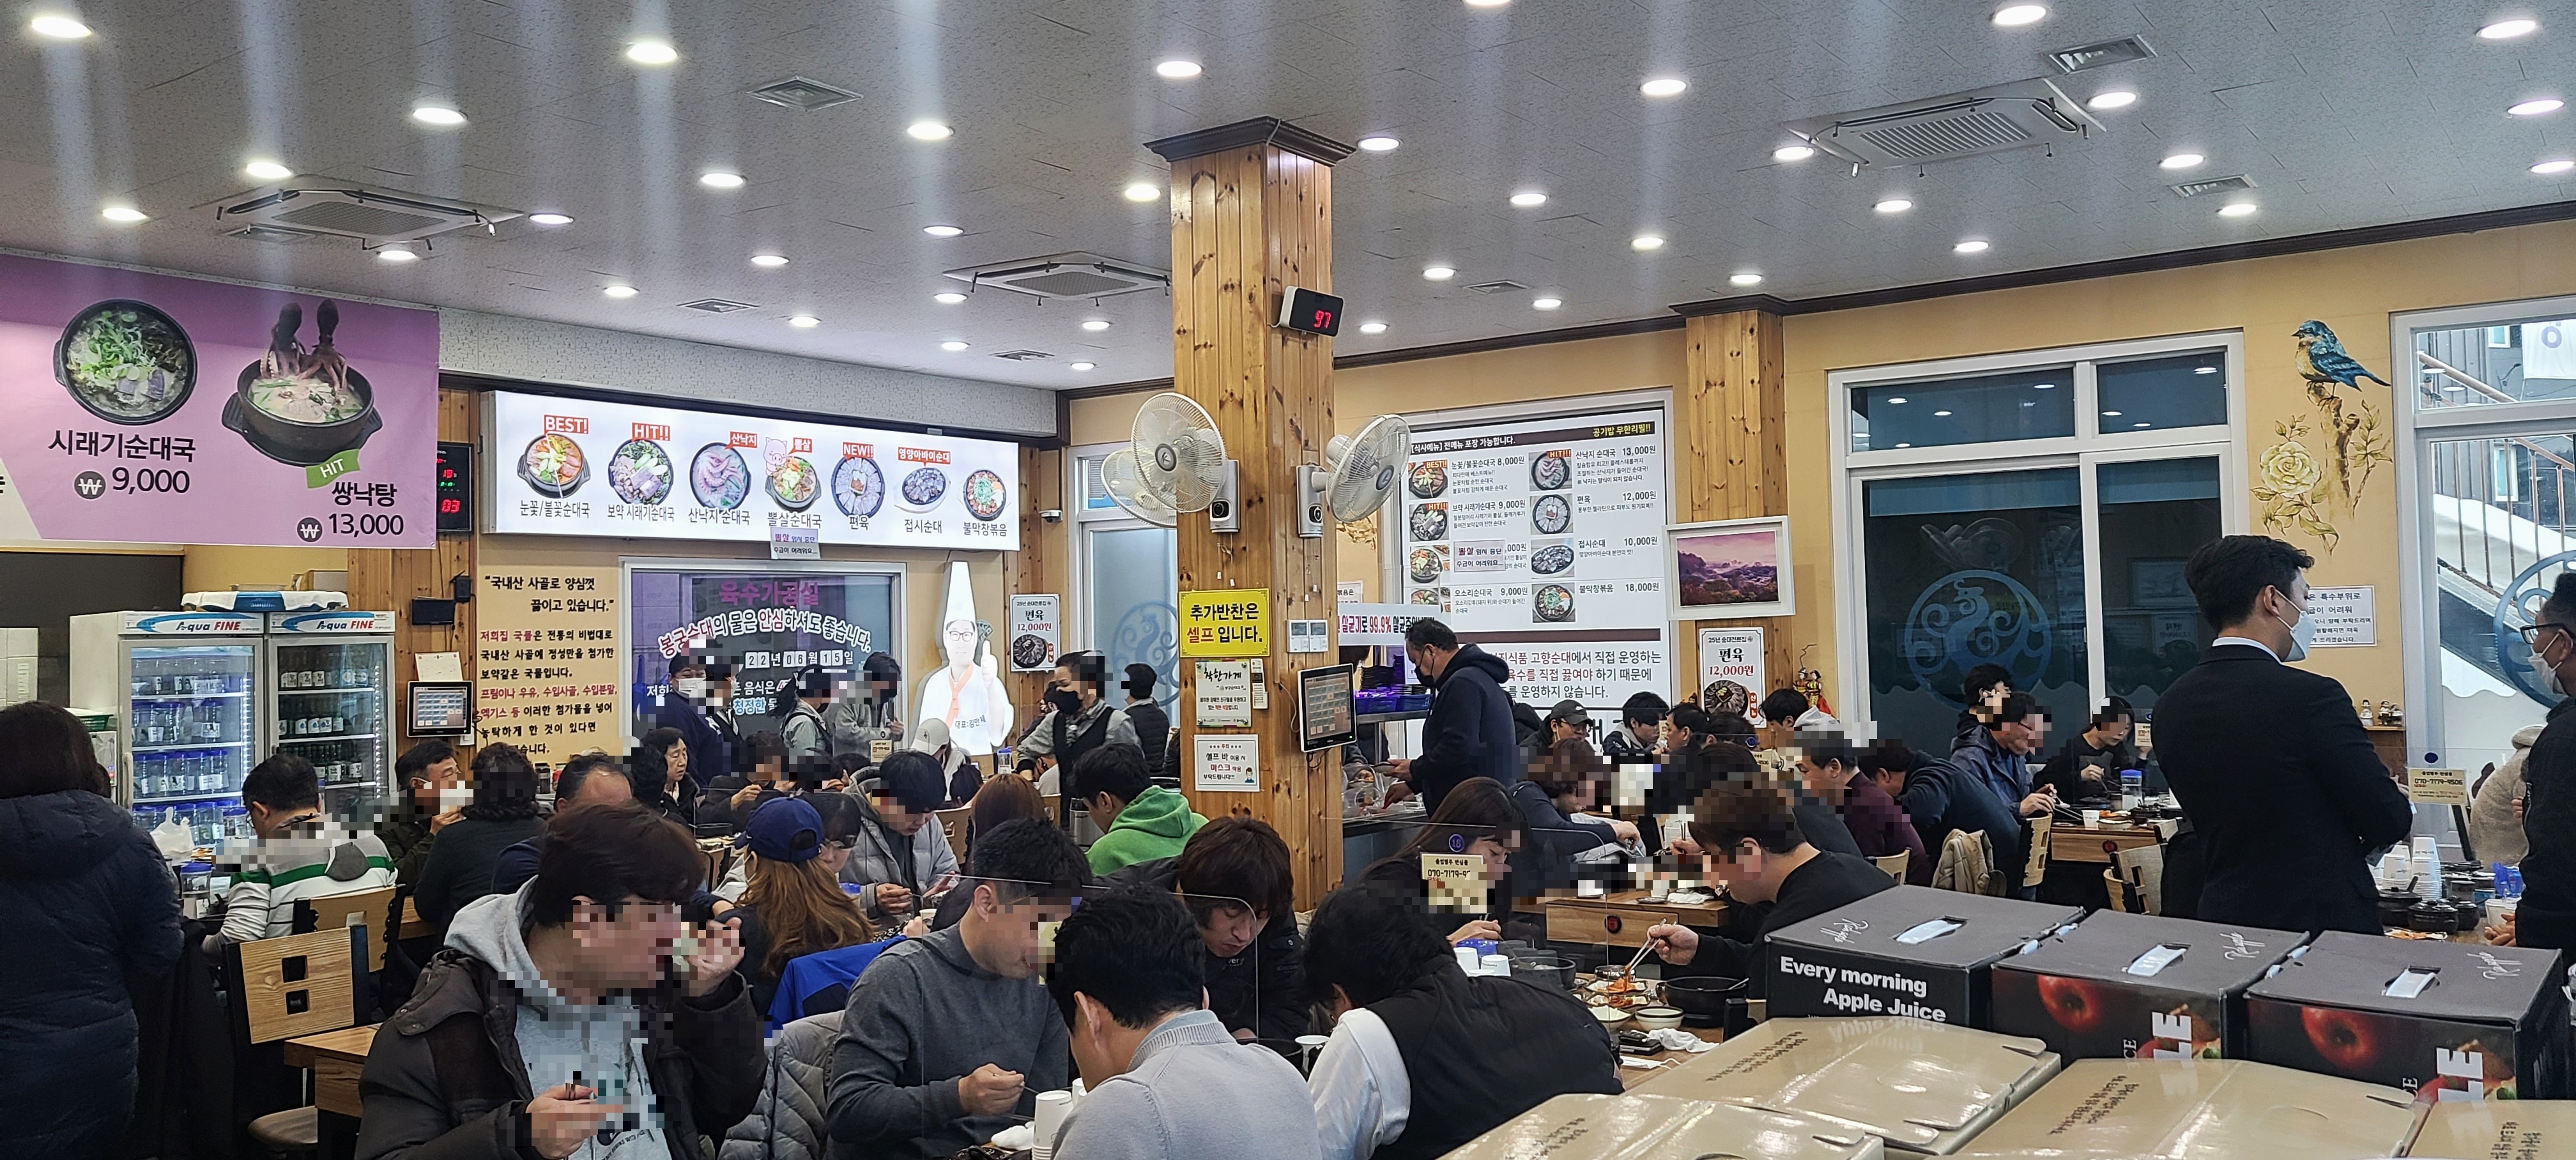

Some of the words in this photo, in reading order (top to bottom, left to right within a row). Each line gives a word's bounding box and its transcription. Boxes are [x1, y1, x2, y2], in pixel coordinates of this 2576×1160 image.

[1314, 310, 1331, 329] 97
[546, 417, 588, 433] BEST!
[1593, 426, 1614, 437] 공기밥
[1616, 424, 1650, 434] 무한리필!!
[634, 425, 670, 441] HIT!!
[731, 433, 757, 446] 산낙지
[48, 430, 195, 462] 시래기순대국
[794, 439, 811, 452] 뽈살
[843, 443, 873, 458] NEW!!
[1411, 442, 1442, 454] [식사메뉴]
[1444, 441, 1464, 450] 전메뉴
[1465, 439, 1478, 448] 포장
[1480, 436, 1515, 447] 가능합니다.
[898, 448, 950, 462] 영양아바이순대
[1575, 450, 1595, 460] 산낙지
[1597, 448, 1616, 458] 순대국
[1622, 445, 1656, 457] 13,000원
[319, 458, 344, 479] HIT
[1426, 460, 1447, 468] BEST!!
[1452, 458, 1496, 470] 눈꽃/불꽃순대국
[1497, 456, 1524, 466] 8,000원
[112, 466, 190, 495] 9,000
[331, 481, 398, 507] 쌍낙탕
[1577, 496, 1590, 504] 편육
[1623, 491, 1656, 501] 12,000원
[520, 500, 590, 519] 눈꽃/불꽃순대국
[1464, 502, 1496, 511] 시래기순대국
[1499, 500, 1526, 510] 9,000원
[608, 504, 624, 518] 보약
[627, 505, 675, 523] 시래기순대국
[688, 508, 718, 524] 산낙지
[722, 509, 751, 525] 순대국
[767, 511, 822, 529] 뽈살순대국
[328, 512, 404, 539] 13,000
[849, 515, 870, 531] 편육
[904, 519, 942, 533] 접시순대
[963, 522, 1007, 537] 불막창볶음
[1578, 539, 1606, 548] 접시순대
[1624, 537, 1658, 547] 10,000원
[528, 577, 561, 590] 사골로
[565, 577, 595, 591] 양심껏
[1579, 584, 1614, 593] 불막창볶음
[1625, 583, 1659, 592] 18,000원
[719, 580, 819, 606] 육수가공실
[1455, 588, 1492, 597] 오소리순대국
[1501, 587, 1528, 597] 9,000원
[2320, 592, 2361, 600] 특수부위로
[531, 599, 563, 612] 끓이고
[1190, 602, 1259, 622] 추가반찬은
[1025, 609, 1045, 621] 편육
[176, 622, 211, 632] Aqua
[213, 621, 241, 631] FINE
[316, 620, 348, 631] Aqua
[350, 620, 374, 630] FINE
[729, 610, 757, 636] 물은
[758, 608, 822, 634] 안심하셔도
[823, 616, 872, 653] 좋습니다.
[1018, 623, 1052, 632] 12,000원
[1342, 615, 1368, 633] 살균기로
[1370, 616, 1392, 634] 99.9%
[480, 630, 509, 642] 저희집
[513, 630, 542, 641] 국물은
[547, 630, 574, 641] 전통의
[578, 630, 613, 639] 비법대로
[1187, 626, 1215, 643] 셀프
[1218, 625, 1262, 643] 입니다.
[480, 650, 510, 661] 국내산
[514, 649, 544, 660] 사골에
[548, 648, 584, 659] 정성만을
[588, 648, 614, 659] 첨가한
[1531, 651, 1591, 664] 고향순대에서
[1595, 651, 1615, 664] 직접
[1619, 650, 1661, 664] 운영하는
[1719, 648, 1744, 662] 편육
[480, 668, 519, 680] 보약같은
[524, 668, 572, 678] 국물입니다.
[1204, 666, 1242, 682] 착한가게
[1539, 669, 1558, 682] 직접
[1561, 668, 1593, 682] 끓여야
[1596, 668, 1616, 682] 하기
[1620, 668, 1652, 682] 때문에
[1709, 665, 1754, 678] 12,000원
[480, 687, 516, 699] 프림이나
[519, 687, 540, 698] 우유,
[543, 685, 579, 698] 수입사골,
[583, 684, 618, 696] 수입분말,
[744, 681, 775, 696] 음식은
[1521, 685, 1560, 698] 운영하지
[1564, 685, 1609, 698] 않습니다.
[480, 707, 508, 719] 엑기스
[511, 706, 520, 717] 등
[524, 705, 551, 717] 이러한
[556, 703, 592, 715] 첨가물을
[595, 702, 613, 713] 넣어
[735, 698, 766, 714] 청정한
[529, 724, 538, 736] 한
[544, 723, 563, 735] 것이
[569, 722, 596, 733] 있다면
[514, 743, 550, 755] 습니다.
[1781, 957, 1837, 984] Every
[1841, 968, 1928, 998] morning
[1823, 987, 1882, 1014] Apple
[1887, 996, 1947, 1022] Juice
